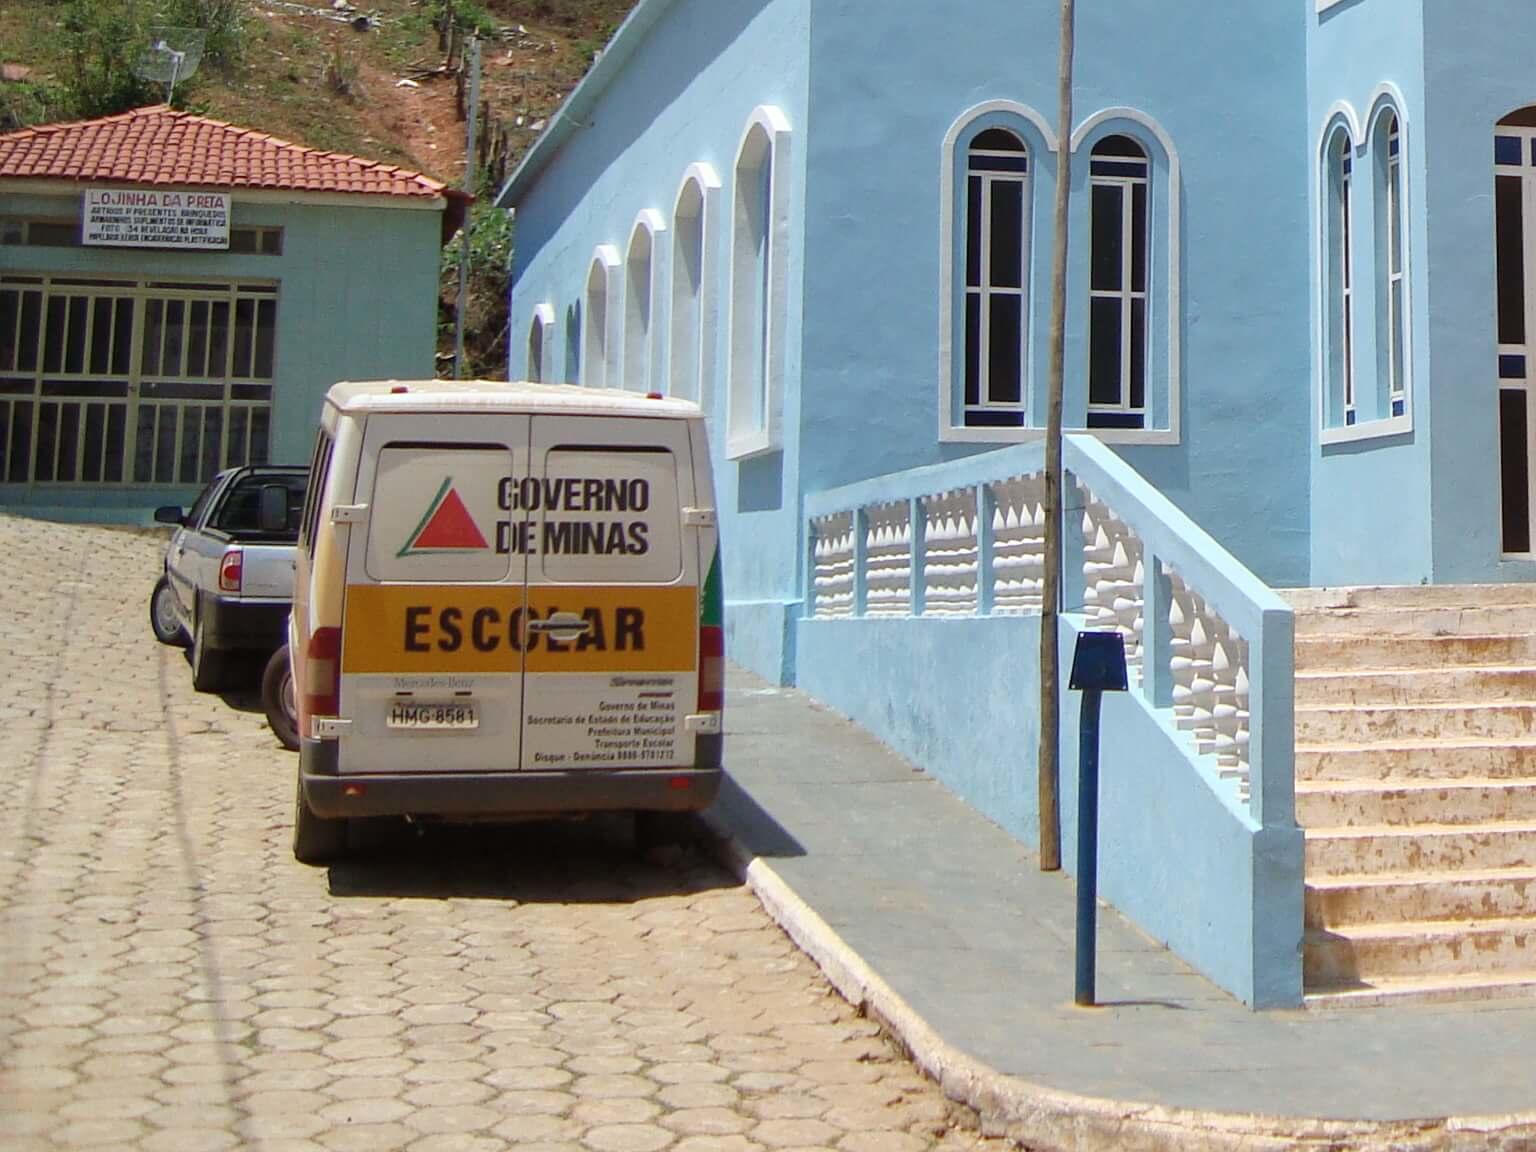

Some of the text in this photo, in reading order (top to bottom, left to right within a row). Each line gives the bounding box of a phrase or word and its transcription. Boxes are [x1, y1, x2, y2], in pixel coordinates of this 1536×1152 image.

[91, 192, 225, 208] LOJINHA DA PRETA
[497, 477, 649, 512] GOVERNO
[495, 521, 649, 555] DE MINAS
[404, 606, 645, 652] ESCOLAR
[599, 701, 675, 711] Governo de Minas
[575, 715, 586, 725] de
[588, 714, 619, 724] Estado
[620, 715, 631, 724] de
[587, 726, 675, 737] Prefeitura Municipal
[595, 738, 674, 749] Transporte Escolar
[534, 752, 565, 763] Disque
